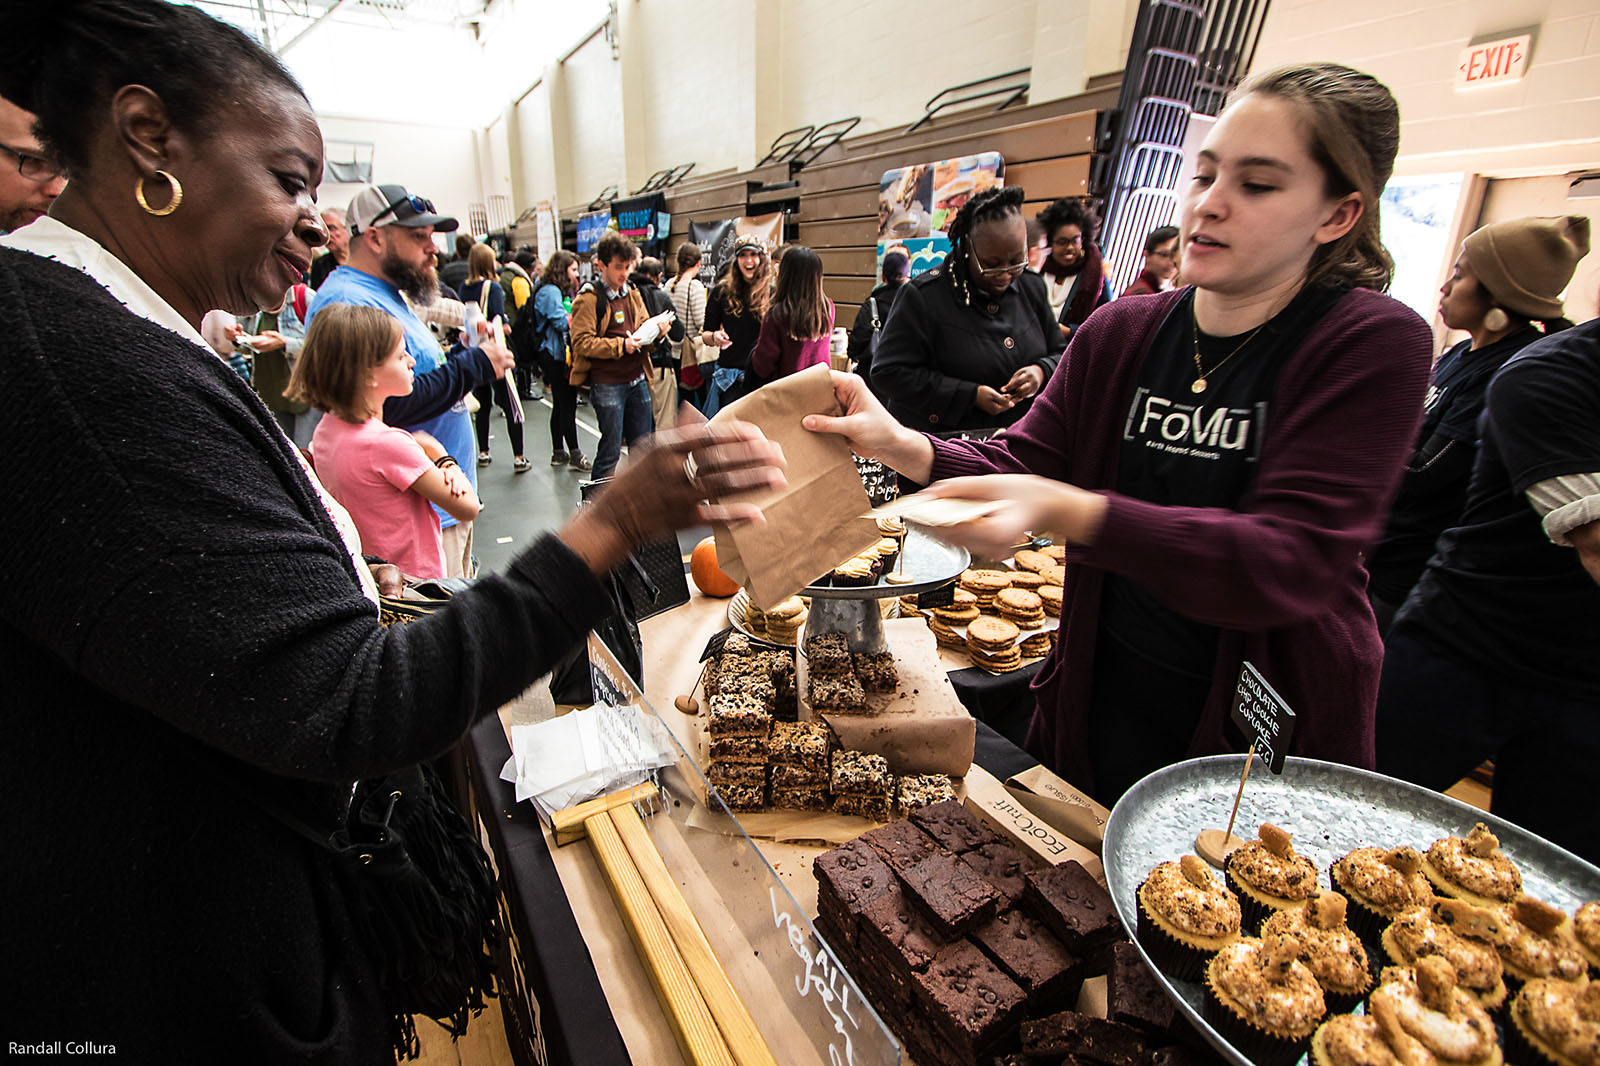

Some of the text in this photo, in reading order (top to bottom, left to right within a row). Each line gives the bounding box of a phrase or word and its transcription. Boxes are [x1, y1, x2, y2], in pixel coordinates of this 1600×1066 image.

[1466, 42, 1520, 81] EXIT
[1242, 670, 1278, 717] CHOCOLATE
[1239, 703, 1271, 745] CUPCAKE
[1253, 701, 1280, 737] COOKIE
[815, 949, 860, 1031] ALL
